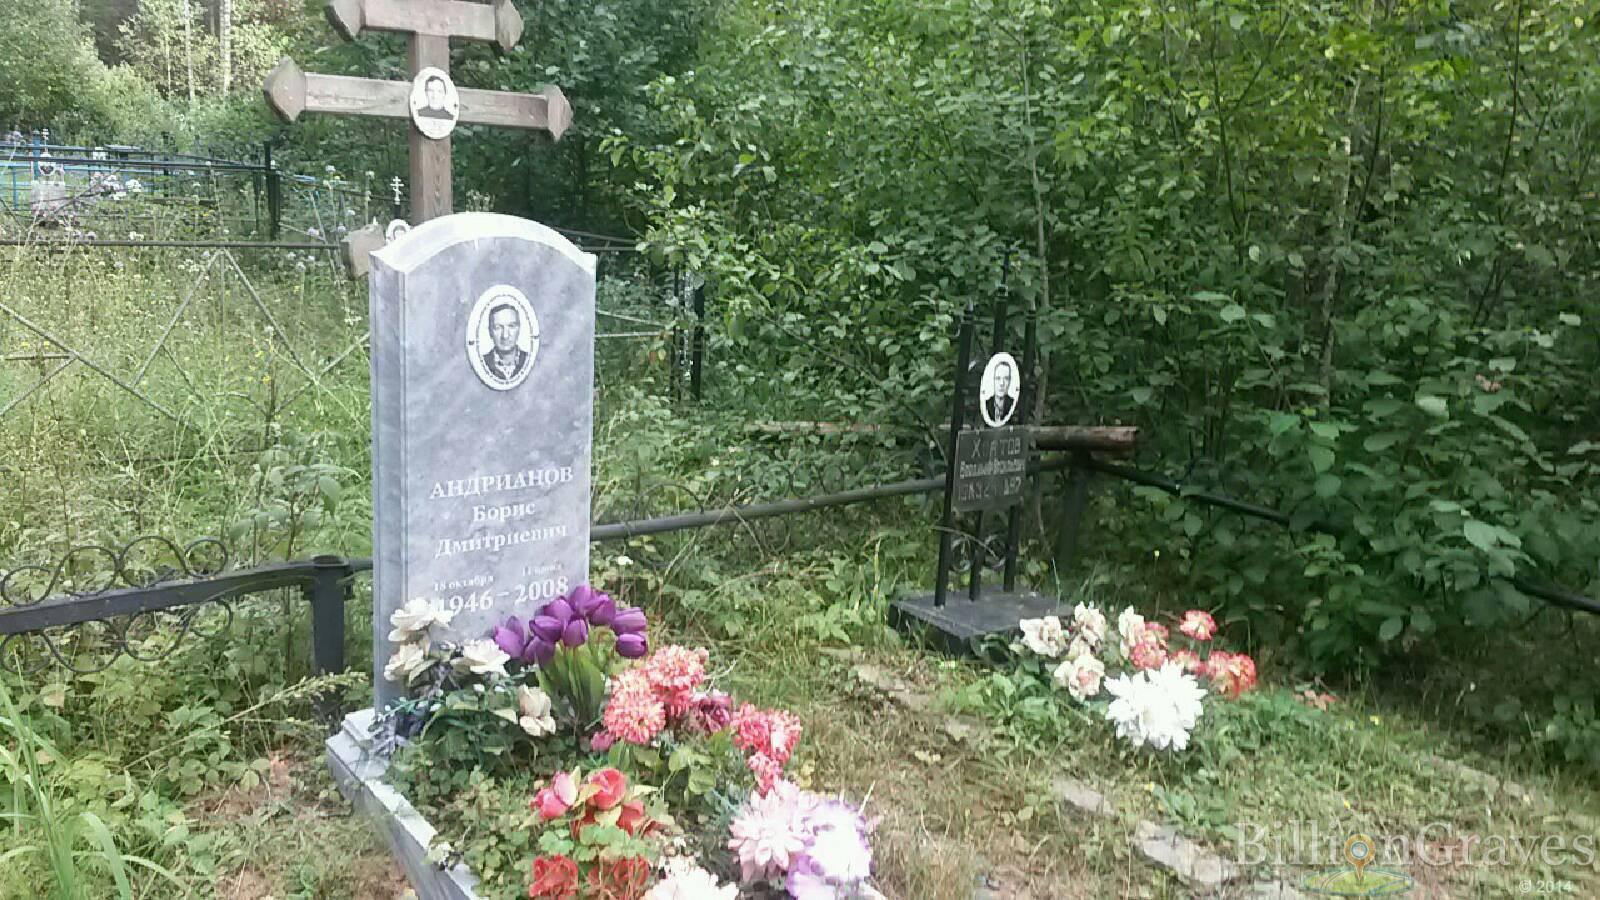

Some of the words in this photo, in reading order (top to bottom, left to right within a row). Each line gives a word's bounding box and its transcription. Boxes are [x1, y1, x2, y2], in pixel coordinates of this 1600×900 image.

[430, 466, 574, 499] АНДРИАНОВ
[473, 503, 536, 523] Борис
[435, 525, 567, 559] Дмитриевич
[514, 576, 569, 606] 2008
